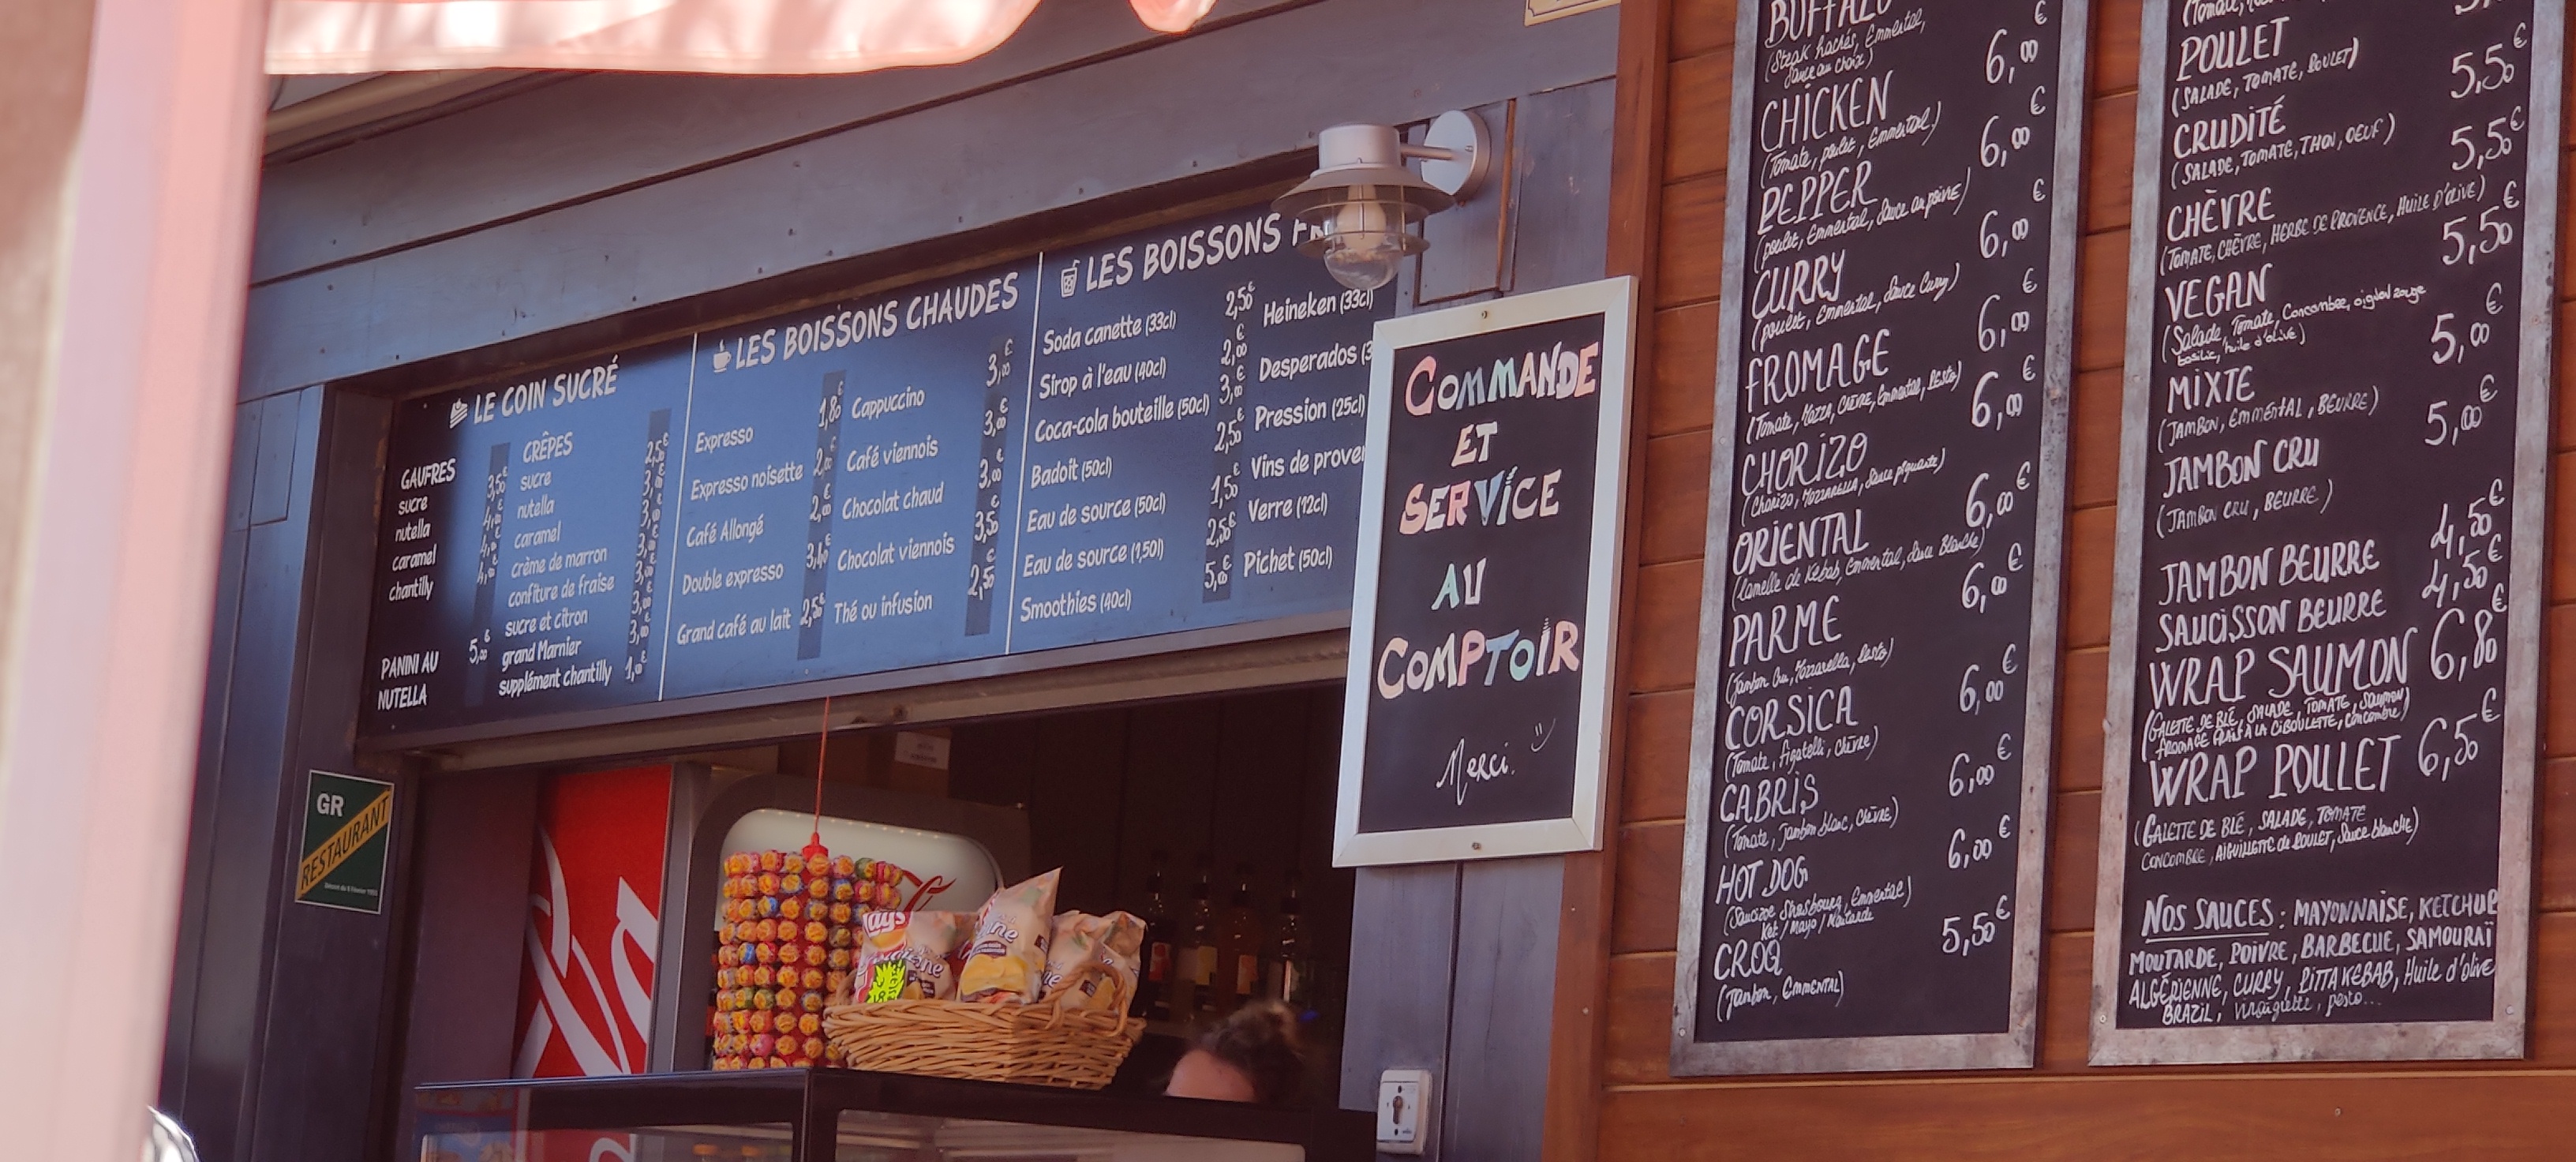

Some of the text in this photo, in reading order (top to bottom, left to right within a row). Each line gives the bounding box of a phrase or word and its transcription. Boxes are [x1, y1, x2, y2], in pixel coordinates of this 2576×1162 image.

[2176, 17, 2290, 85] POULET
[1758, 156, 1878, 238] PEPPER
[1086, 246, 1133, 291] LES
[1143, 212, 1281, 280] BOISSONS
[1752, 246, 1844, 323] CURRY
[2165, 263, 2273, 322] VEGAN
[736, 272, 1018, 369] LES BOISSONS CHAUDES
[1264, 289, 1373, 328] Heineken (33cl)
[1043, 309, 1176, 354] Soda canette (33cl)
[1039, 357, 1166, 399] Sirop à l'eau (40cl)
[1260, 343, 1357, 382] Desperados
[1404, 340, 1601, 417] COMMANDE
[474, 354, 618, 423] LE COIN SUCRÉ
[852, 386, 925, 420] Cappuccino
[1035, 394, 1209, 442] Coca-cola bouteille (50cl)
[1255, 394, 1365, 431] Pression (25cl)
[523, 431, 573, 463] CRÊPES
[695, 427, 753, 453] Expresso
[847, 435, 938, 471] Café viennois
[1451, 421, 1498, 467] ET
[401, 458, 455, 489] GAUFRES
[520, 471, 552, 491] sucre
[691, 462, 803, 501] Expresso noisette
[1031, 456, 1112, 489] Badoit (50cl)
[1252, 454, 1284, 479] Vins
[1290, 449, 1309, 474] de
[2163, 437, 2319, 498] JAMBON CRU
[399, 497, 428, 515] sucre
[517, 493, 555, 519] nutella
[842, 482, 944, 519] Chocolat chaud
[1027, 493, 1166, 532] Eau de source (50cl)
[1249, 493, 1327, 522] Verre (12cl)
[395, 518, 431, 542] nutella
[515, 521, 561, 549] caramel
[687, 514, 763, 547] Café Allongé
[392, 544, 436, 571] caramel
[511, 548, 608, 579] crème de marron
[837, 532, 955, 571] Chocolat viennois
[1244, 545, 1332, 577] Pichet (50cl)
[389, 575, 433, 601] chantilly
[508, 572, 614, 607] confiture de fraise
[682, 564, 783, 595] Double expresso
[1431, 557, 1487, 610] AU
[2159, 539, 2379, 605] JAMBON BEURRE
[505, 607, 588, 636] sucre et citron
[834, 590, 932, 624] Thé ou infusion
[1020, 589, 1131, 621] Smoothies (40cl)
[2297, 589, 2387, 633] BEURRE
[676, 608, 792, 645] Grand café au lait
[1728, 595, 1841, 668] PARME
[381, 651, 439, 680] PANINI AU
[502, 636, 582, 672] grand Marnier
[1377, 617, 1581, 699] COMPTOIR
[2149, 627, 2418, 711] WRAP SAUMON
[378, 684, 427, 710] NUTELLA
[499, 659, 612, 698] supplément chantilly
[2150, 735, 2401, 807] WRAP POULET
[316, 793, 344, 817] GR
[301, 796, 389, 890] RESTAURANT
[1716, 856, 1808, 905] HOT DOG
[2193, 898, 2274, 931] SAUCES
[1714, 939, 1783, 980] CROQ
[2301, 931, 2394, 958] BARBECUE
[2233, 968, 2284, 1000] CURRY
[2403, 956, 2442, 985] Huile
